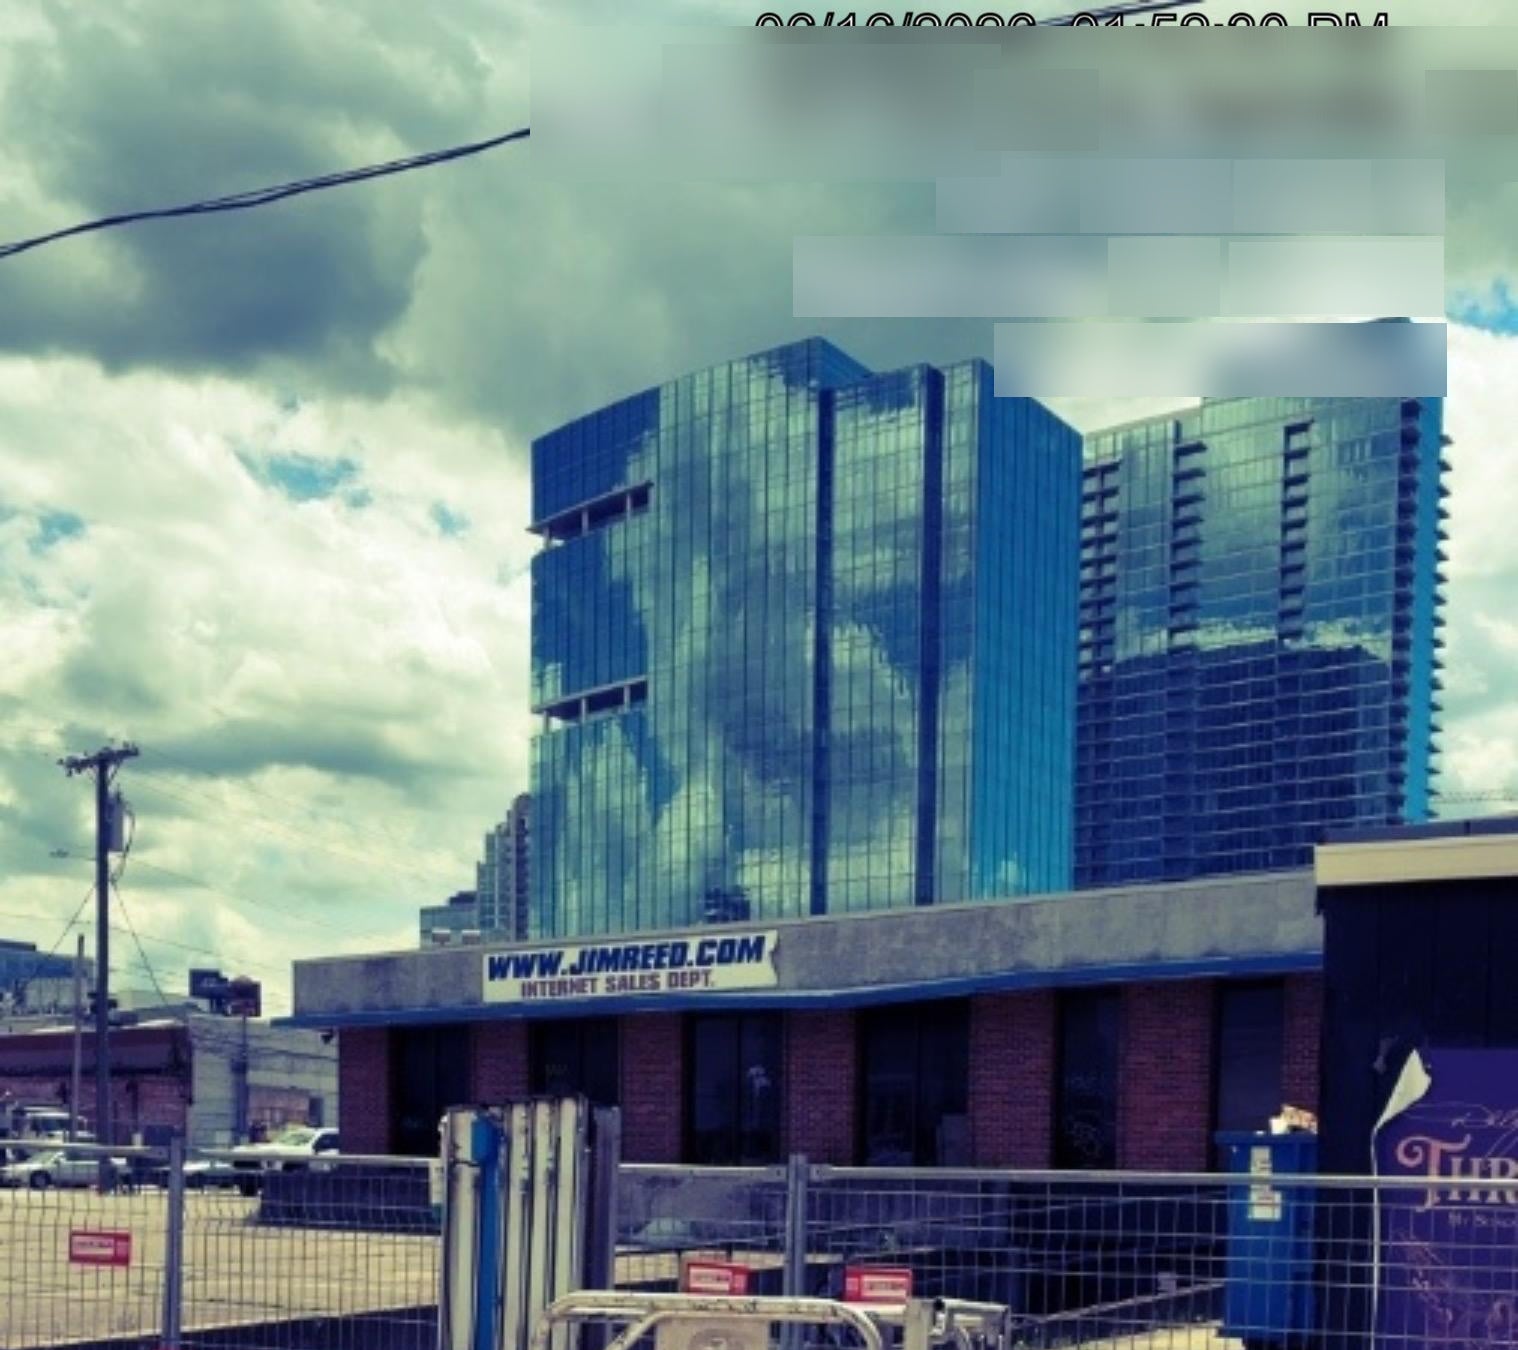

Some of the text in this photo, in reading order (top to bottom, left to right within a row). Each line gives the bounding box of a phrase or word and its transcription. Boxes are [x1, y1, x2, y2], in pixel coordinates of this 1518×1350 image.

[488, 935, 766, 981] WWW.JIMREED.COM
[521, 968, 716, 999] INTERNET SALES DEPT.
